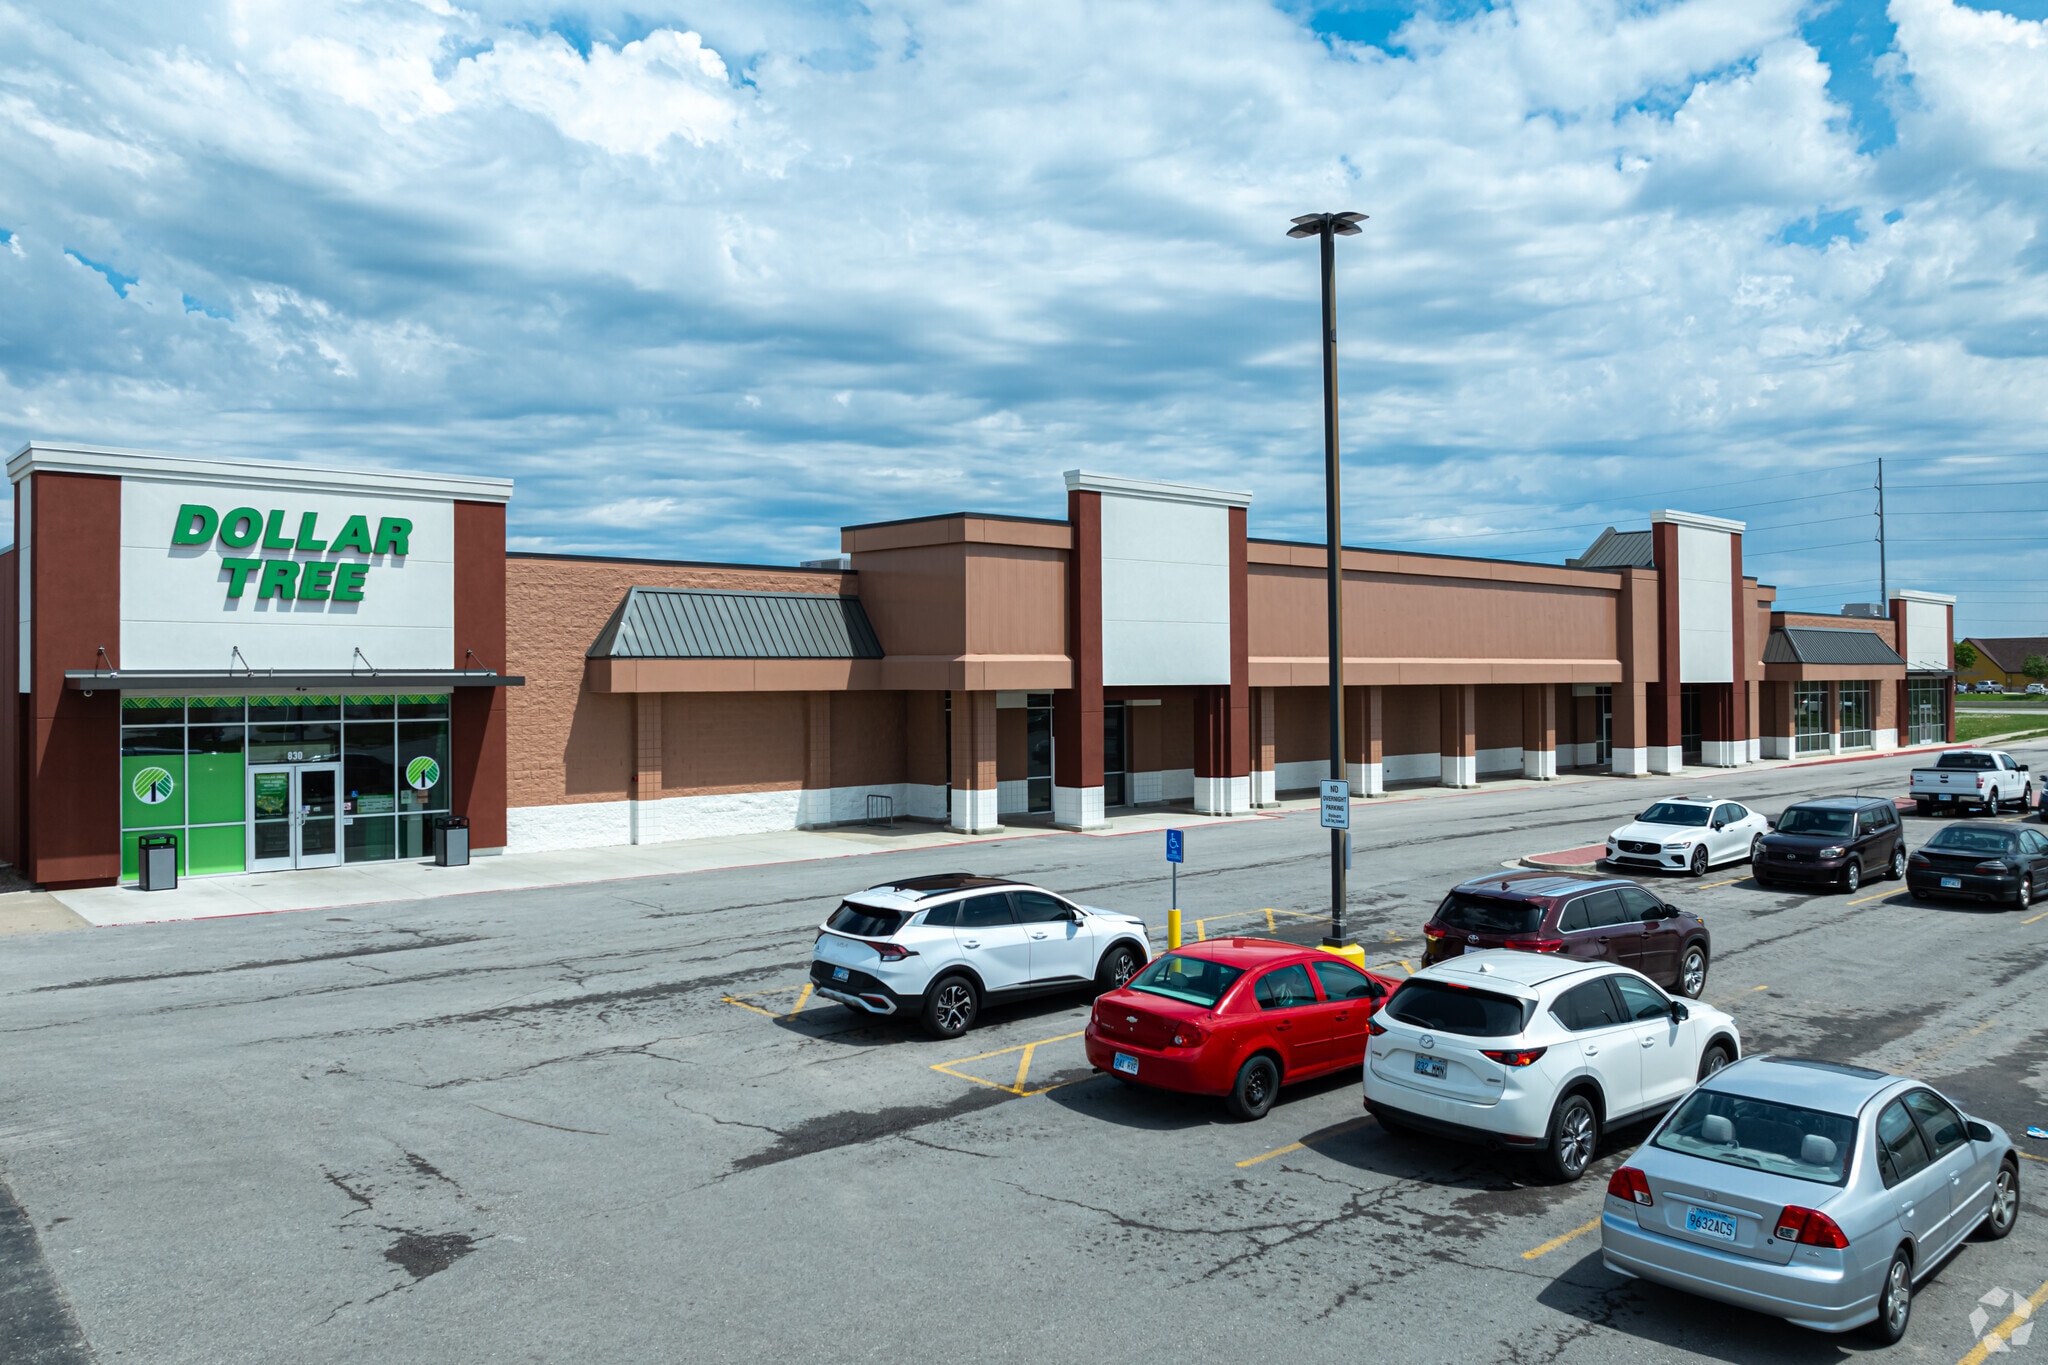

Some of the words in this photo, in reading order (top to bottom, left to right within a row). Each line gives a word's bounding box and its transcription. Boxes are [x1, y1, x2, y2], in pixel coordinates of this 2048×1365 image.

[172, 503, 413, 556] DOLLAR
[221, 557, 371, 601] TREE
[287, 751, 303, 760] 830
[1330, 785, 1339, 793] NO
[1416, 1060, 1429, 1072] 232
[1690, 1214, 1733, 1236] 9632ACS
